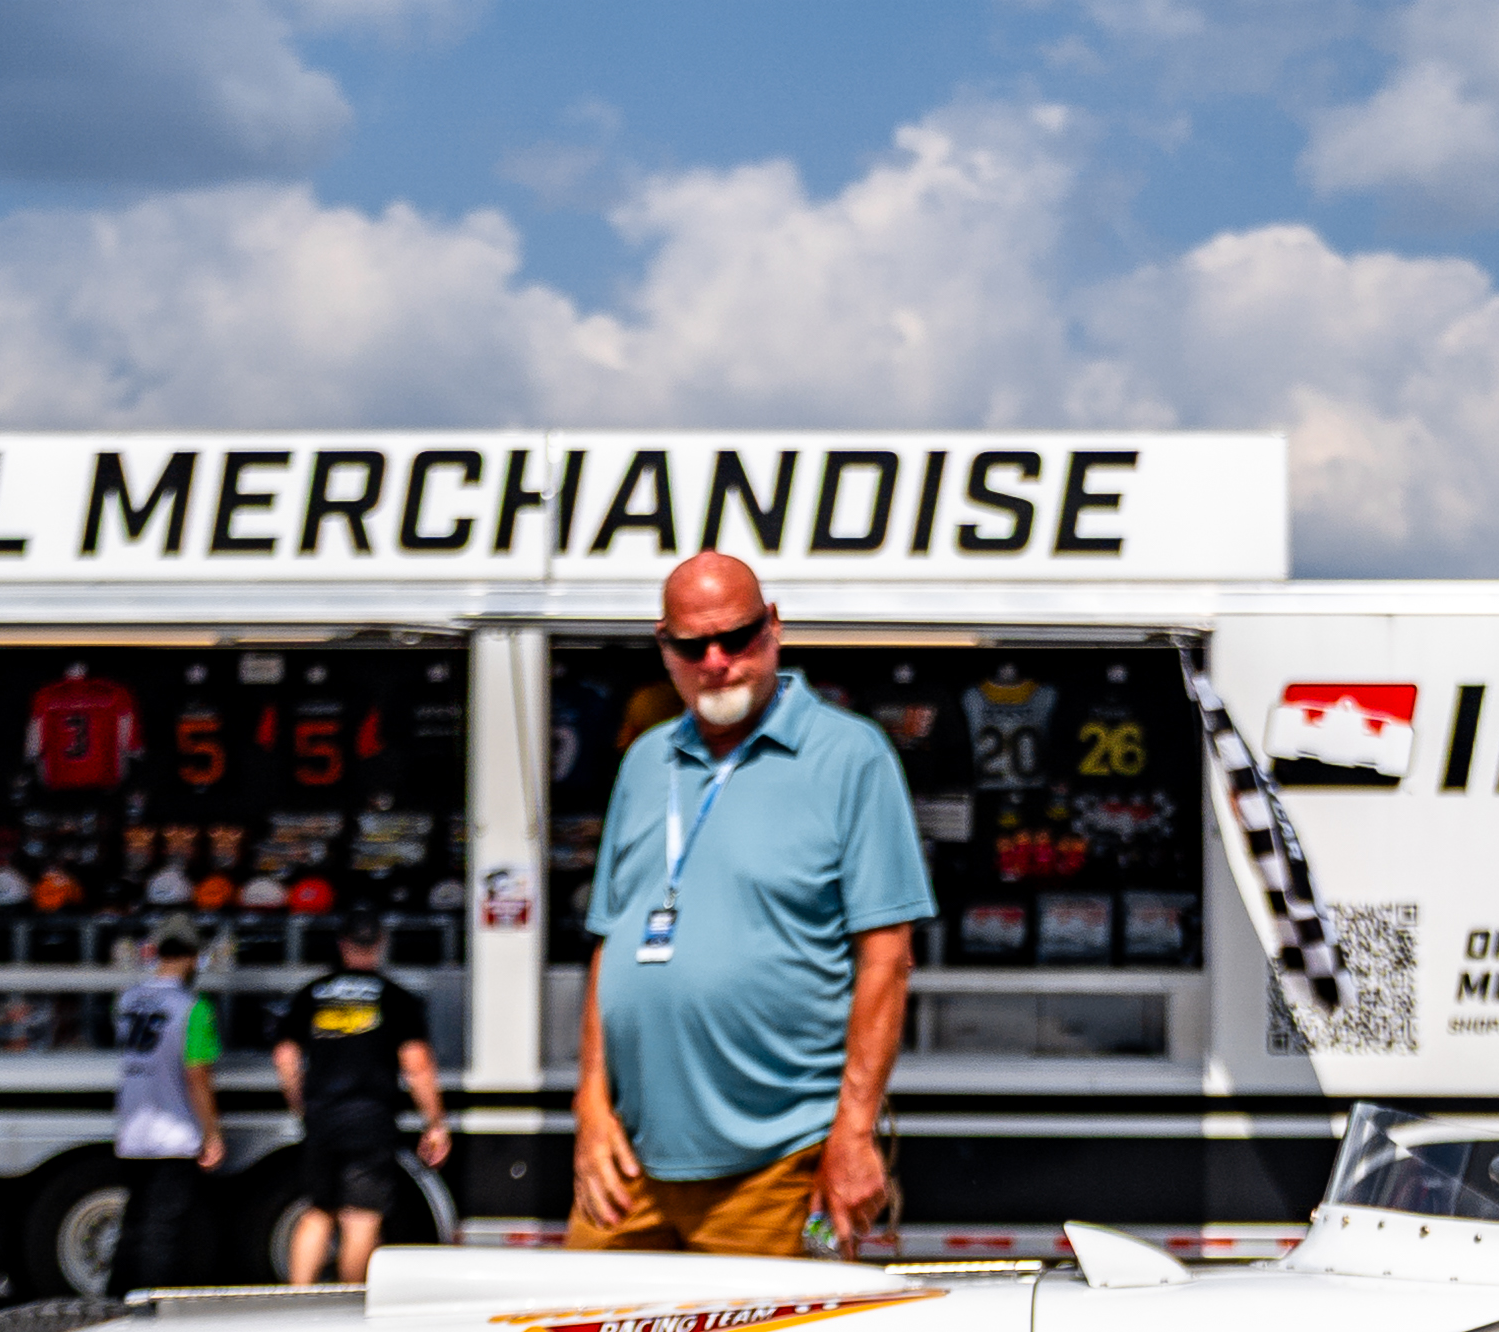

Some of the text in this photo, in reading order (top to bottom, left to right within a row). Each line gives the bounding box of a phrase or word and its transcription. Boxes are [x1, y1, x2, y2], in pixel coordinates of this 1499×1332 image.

[79, 449, 1140, 555] MERCHANDISE
[176, 718, 227, 785] 5
[295, 719, 344, 786] 5
[1078, 720, 1147, 777] 26
[704, 1306, 777, 1331] TEAM
